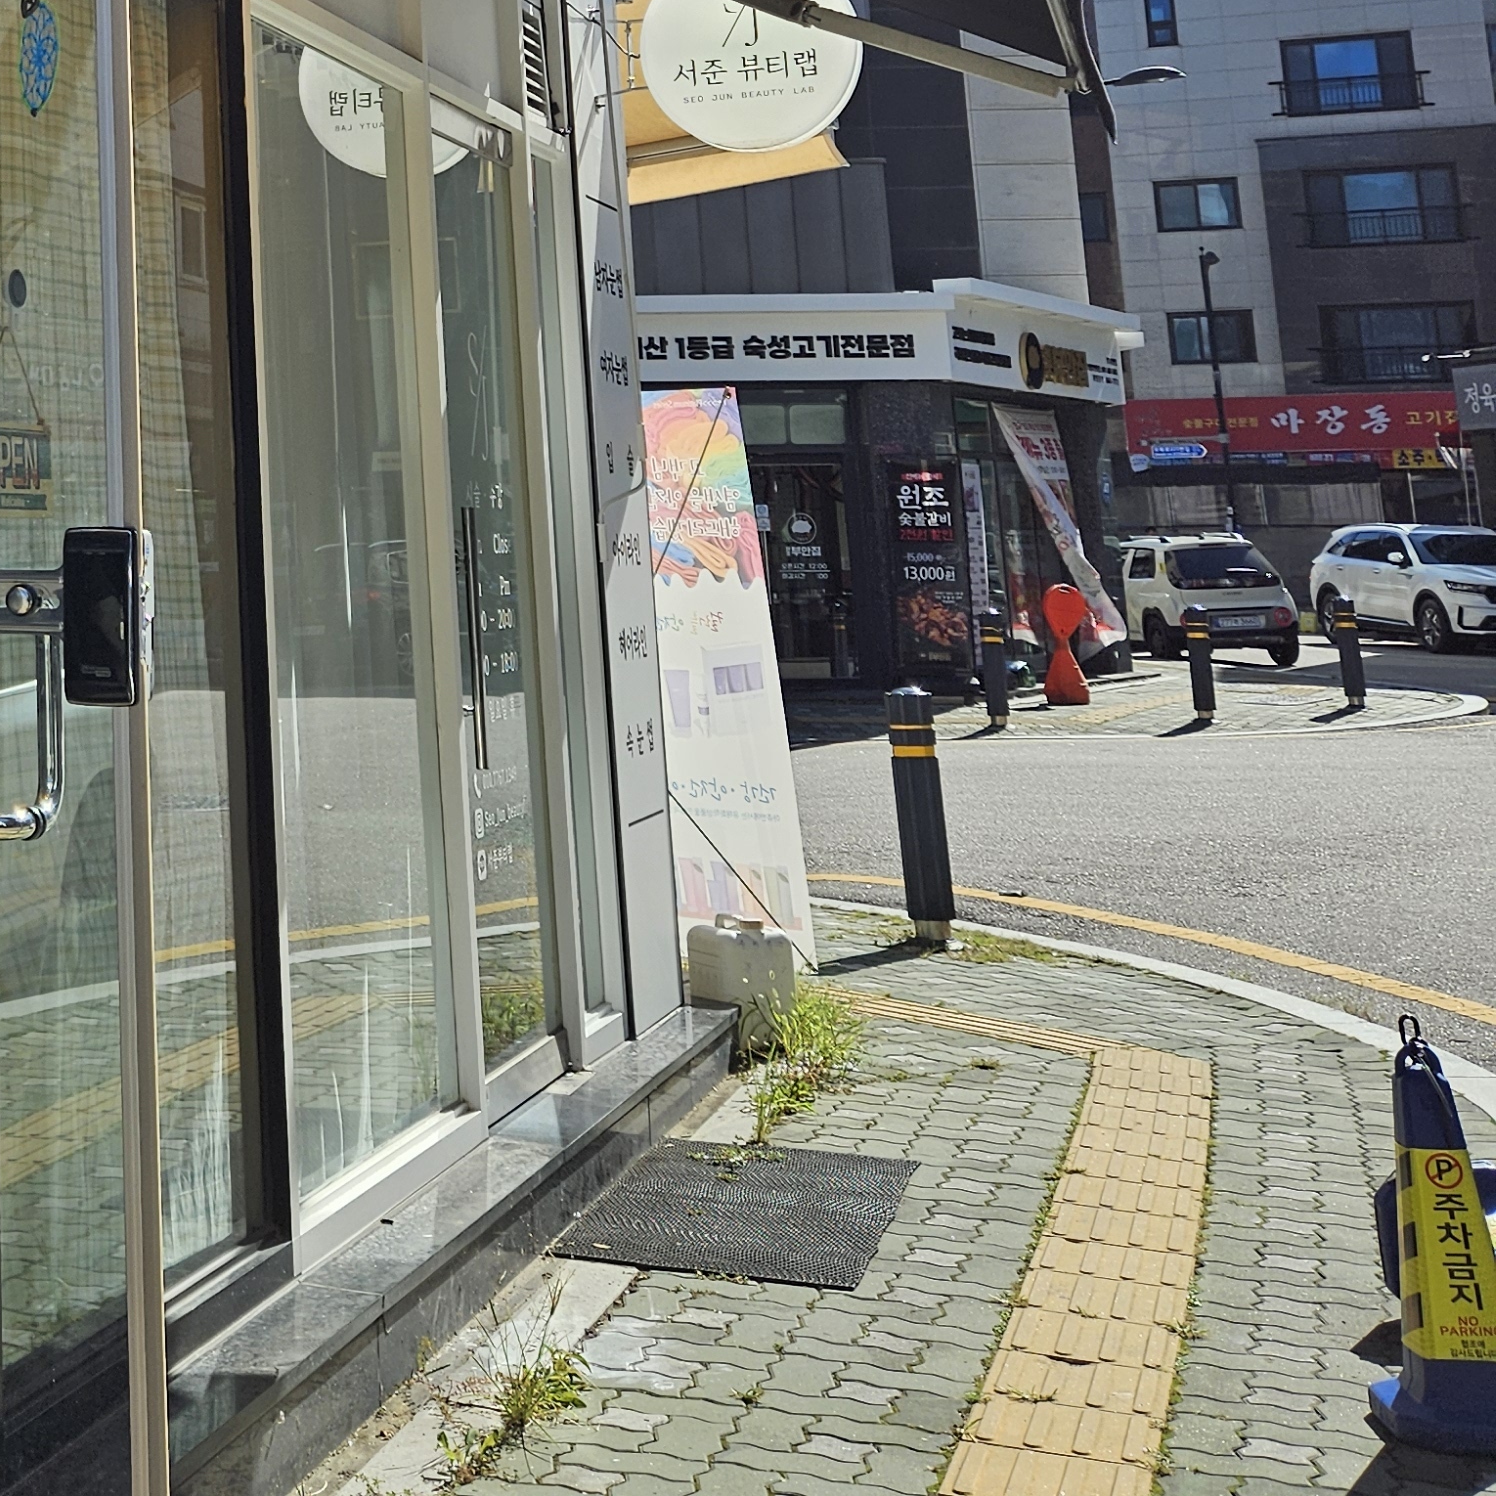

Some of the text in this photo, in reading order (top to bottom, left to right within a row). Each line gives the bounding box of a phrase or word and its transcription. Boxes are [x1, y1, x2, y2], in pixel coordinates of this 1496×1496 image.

[674, 47, 818, 87] 서준 뷰티랩
[683, 85, 816, 104] SEO JUN BEAUTY LAB
[594, 260, 623, 299] 남자눈썹
[675, 336, 734, 360] 1등급
[743, 334, 916, 359] 숙성고기전문점
[600, 350, 629, 386] 여자눈썹
[1270, 404, 1392, 434] 마장동
[1397, 449, 1425, 466] 소주
[896, 484, 949, 510] 원조
[898, 511, 952, 527] 숯불갈비
[612, 533, 641, 567] 아이라인
[904, 565, 956, 582] 13,000원
[619, 625, 647, 660] 헤어라인
[626, 718, 654, 757] 속눈썹
[1433, 1193, 1484, 1311] 주차금지
[1458, 1315, 1479, 1326] NO
